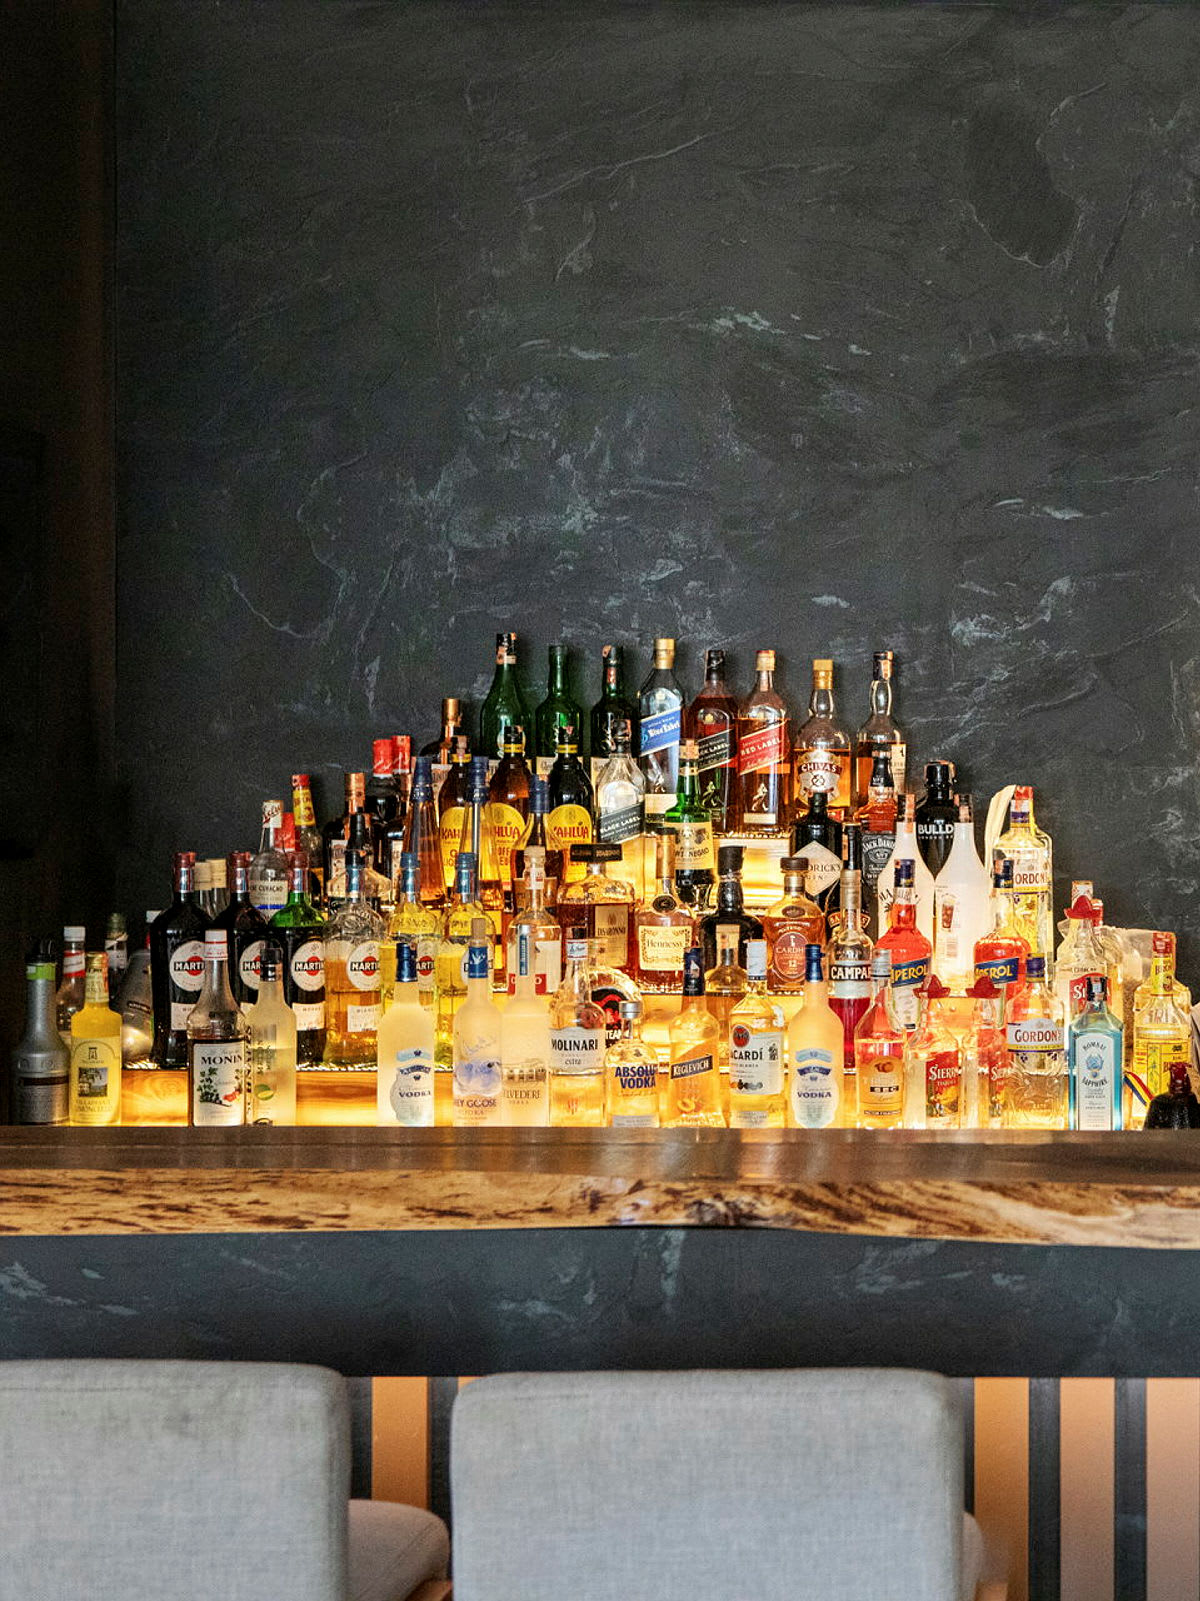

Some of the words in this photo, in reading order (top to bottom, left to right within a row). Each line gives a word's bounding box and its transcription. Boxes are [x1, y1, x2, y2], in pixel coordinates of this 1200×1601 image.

[801, 762, 837, 772] CHIVAS
[620, 816, 641, 827] LABEL
[917, 824, 954, 834] BULLD
[551, 1038, 598, 1051] MOLINARI
[673, 1059, 709, 1077] KEGLEVICH
[620, 1077, 656, 1089] VODKA
[796, 1091, 832, 1099] VODKA
